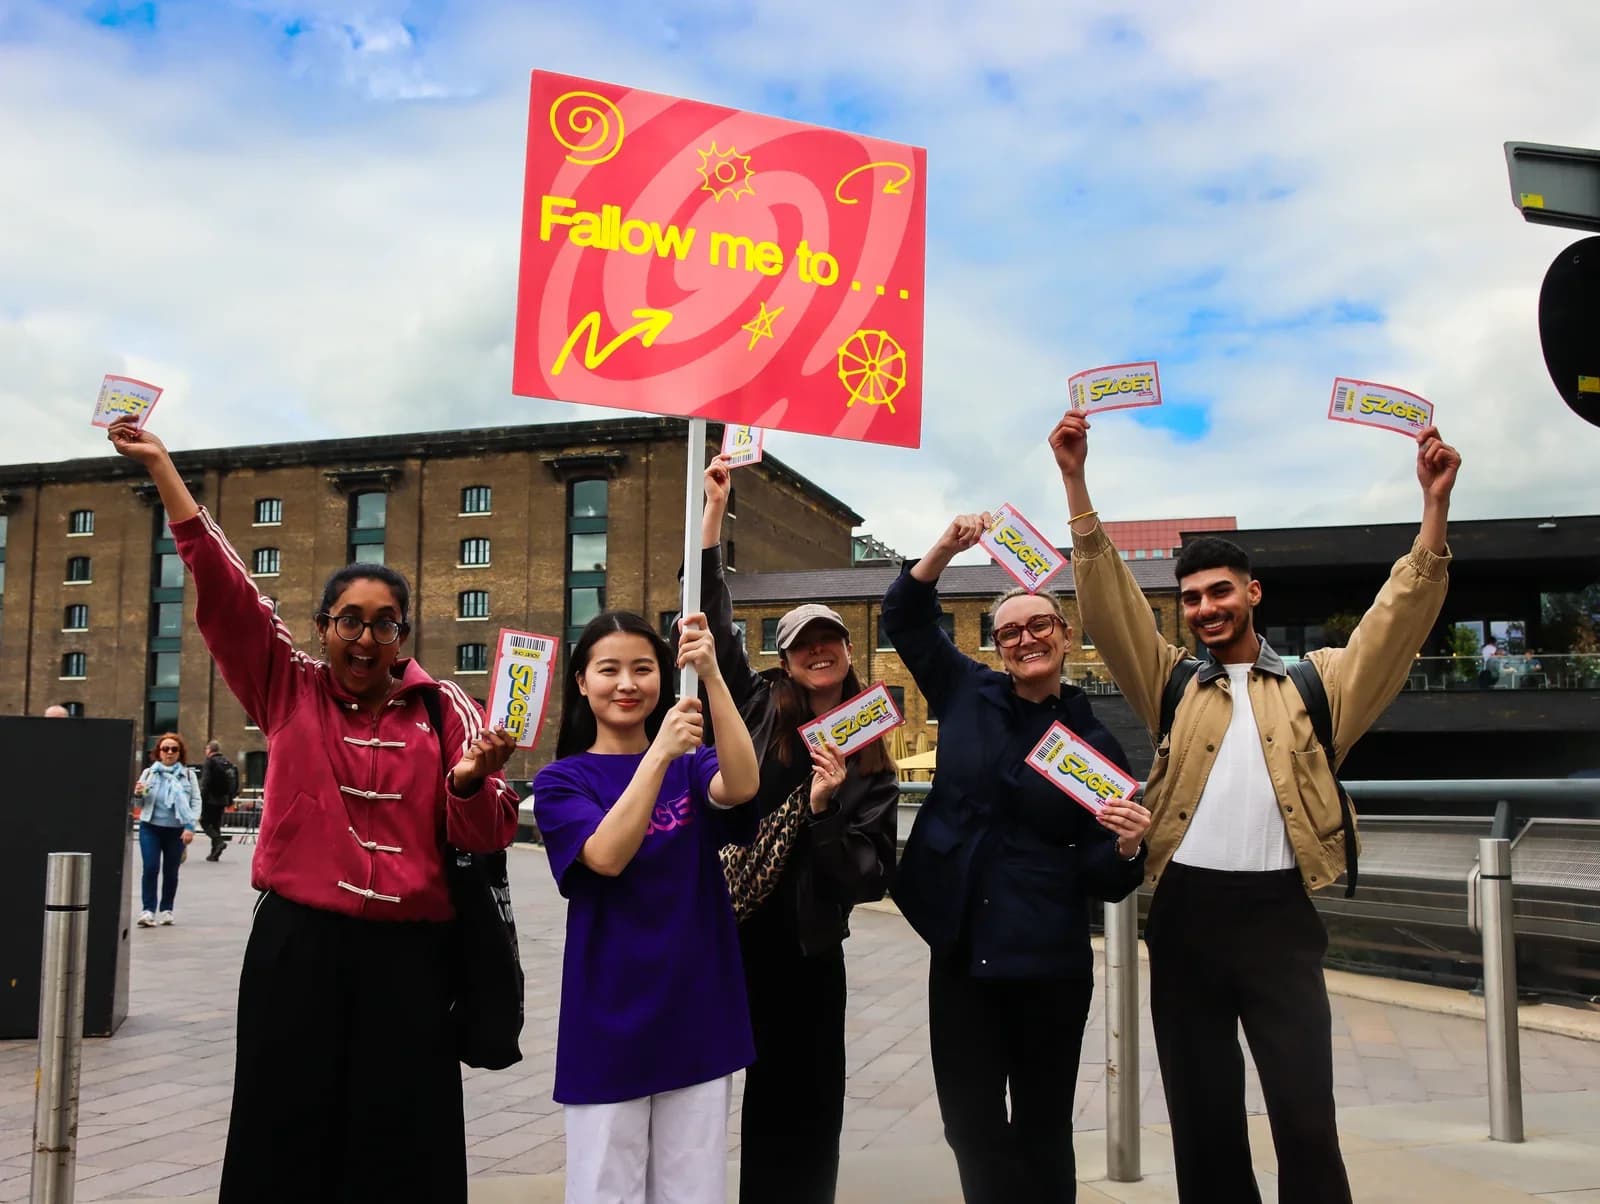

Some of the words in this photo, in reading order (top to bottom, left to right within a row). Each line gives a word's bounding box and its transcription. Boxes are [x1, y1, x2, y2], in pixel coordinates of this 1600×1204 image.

[541, 195, 696, 260] Fallow
[709, 232, 784, 276] me
[795, 240, 840, 286] to
